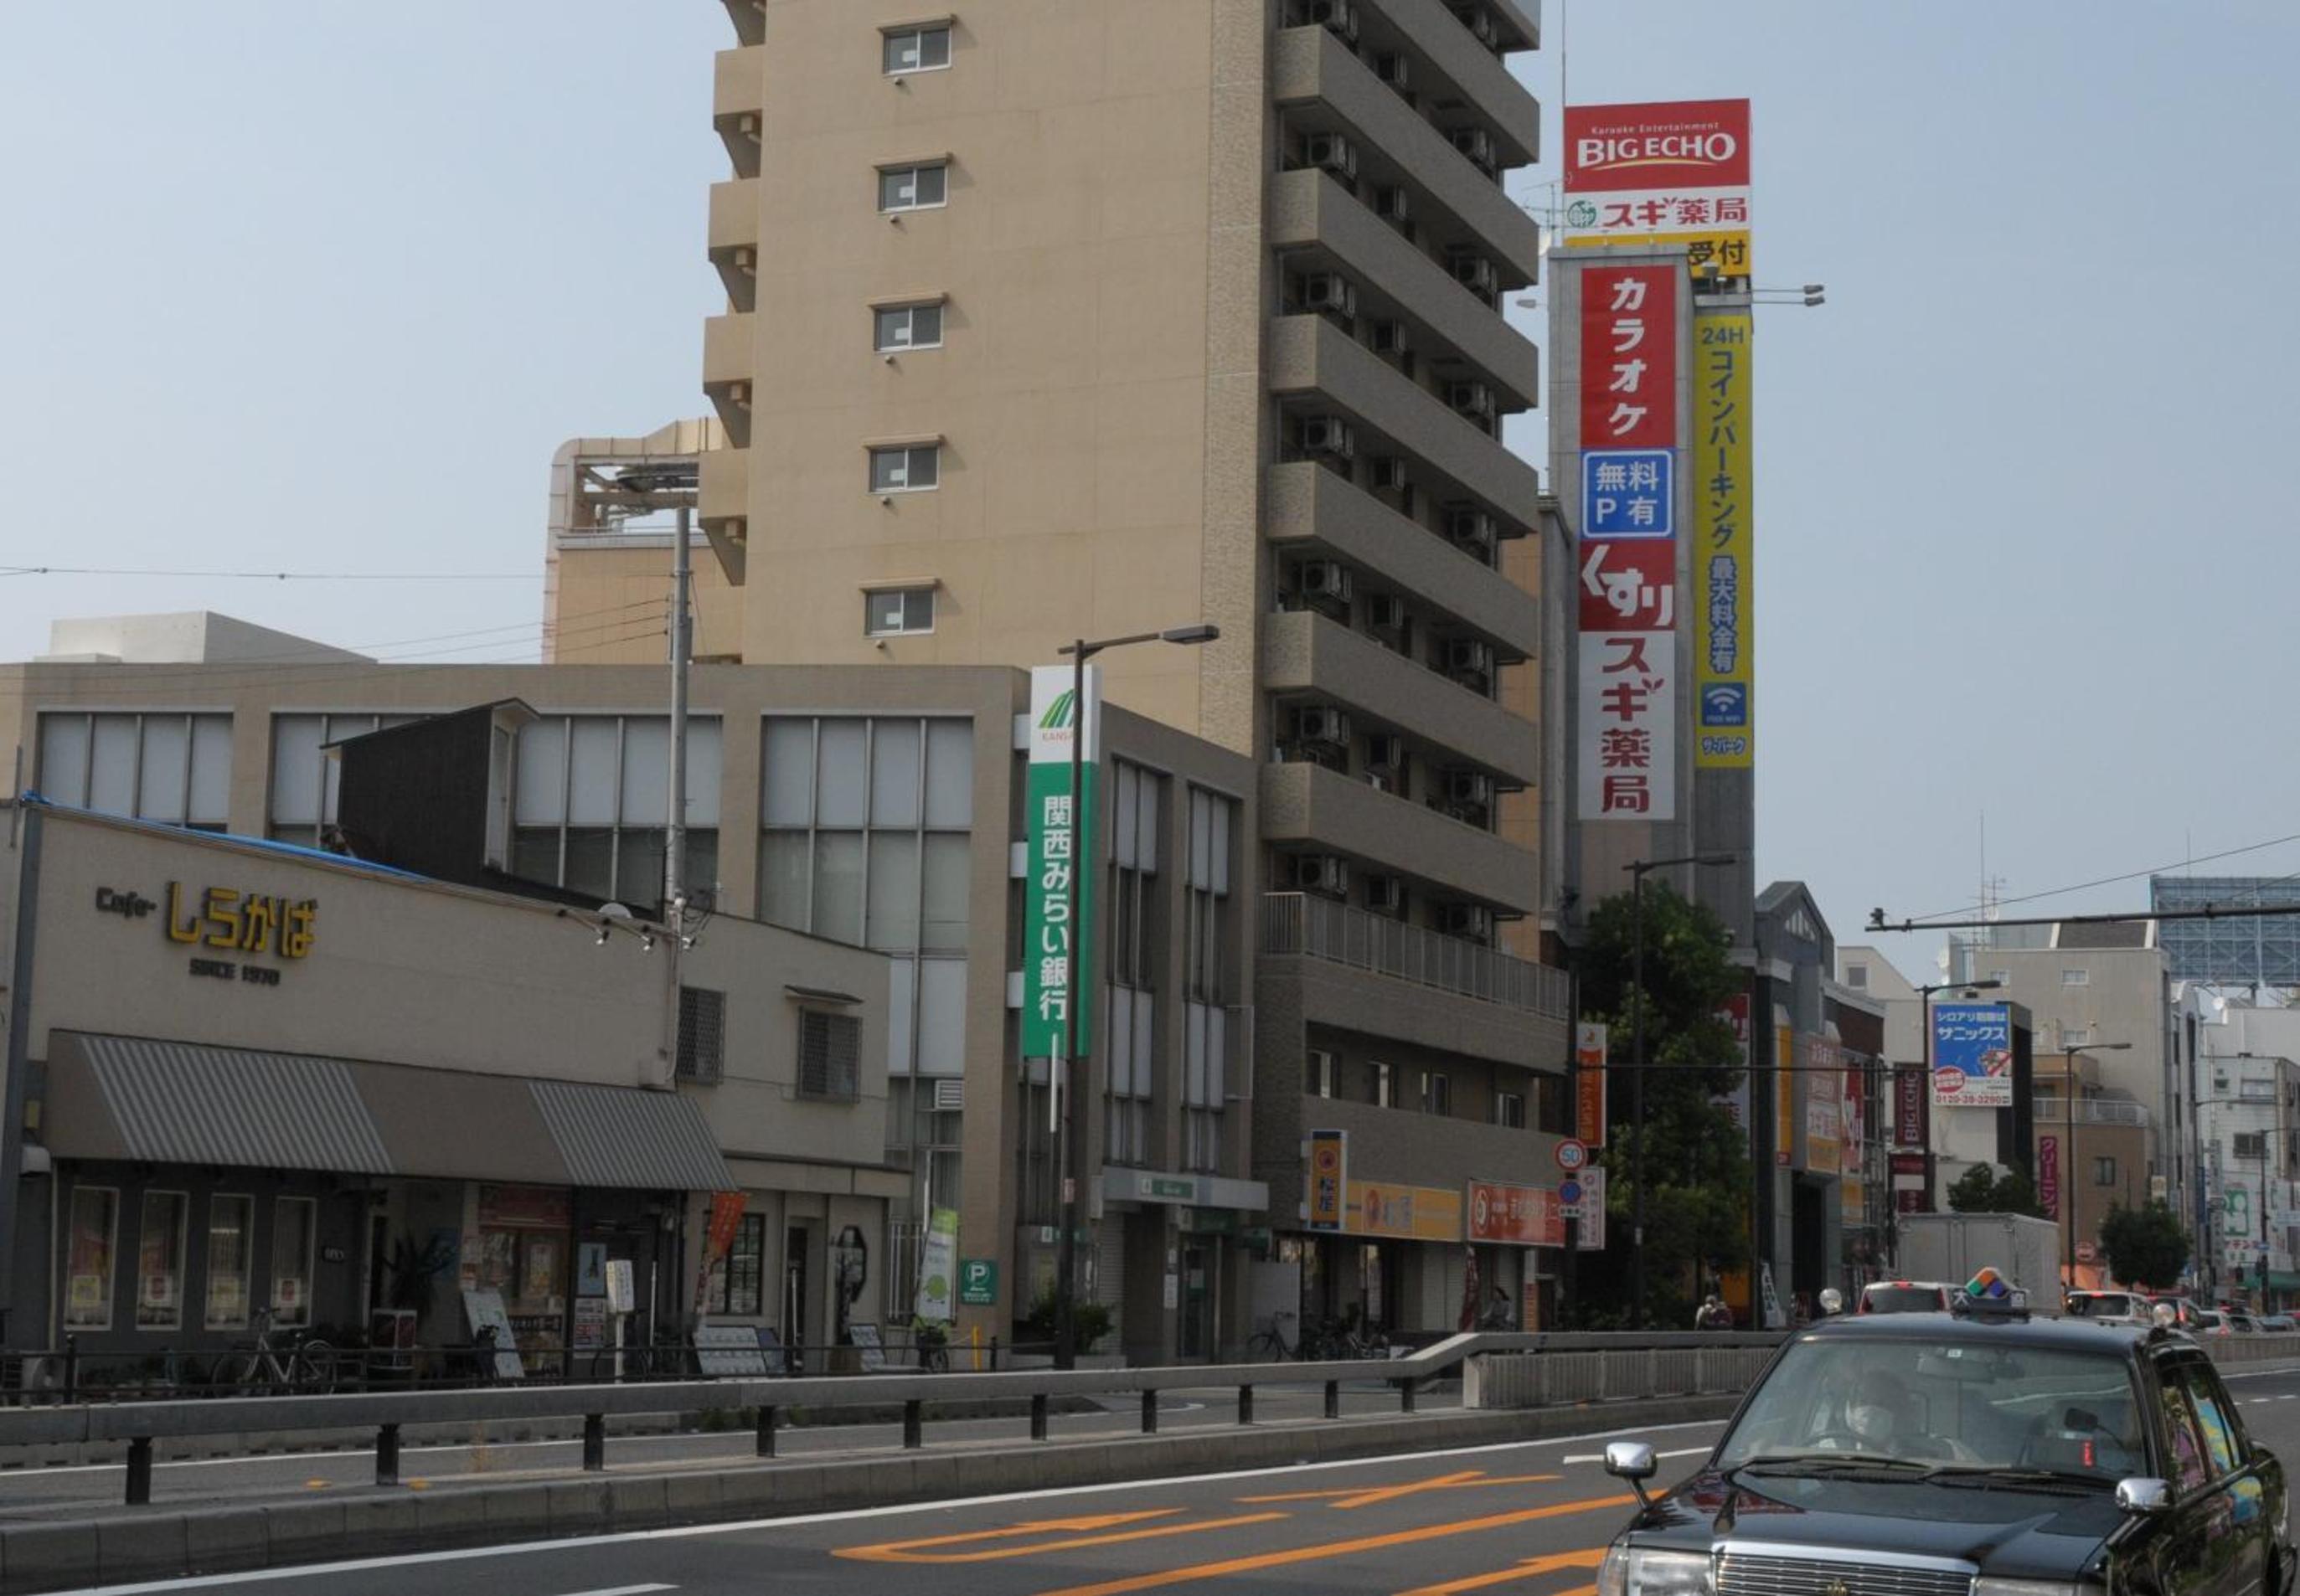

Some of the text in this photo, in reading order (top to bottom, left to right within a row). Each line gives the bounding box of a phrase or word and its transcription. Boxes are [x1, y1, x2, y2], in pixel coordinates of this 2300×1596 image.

[1591, 122, 1720, 135] Karaoke Entertainment
[1578, 133, 1736, 167] BIG ECHO
[1602, 197, 1747, 228] スギ薬局
[1689, 239, 1746, 266] 受付
[1702, 327, 1744, 345] 24H
[1609, 277, 1648, 435] カラオケ
[1710, 351, 1736, 548] コインパーキング
[1596, 461, 1658, 492] 無料
[1581, 544, 1673, 626] くすり
[1601, 637, 1664, 813] スギ薬局
[168, 881, 317, 959] しらかば
[1039, 795, 1072, 1021] 関西みらい銀行
[189, 958, 236, 980] SINCE
[1937, 1027, 2006, 1041] サニックス
[1562, 1147, 1580, 1163] 50
[970, 1264, 986, 1282] P
